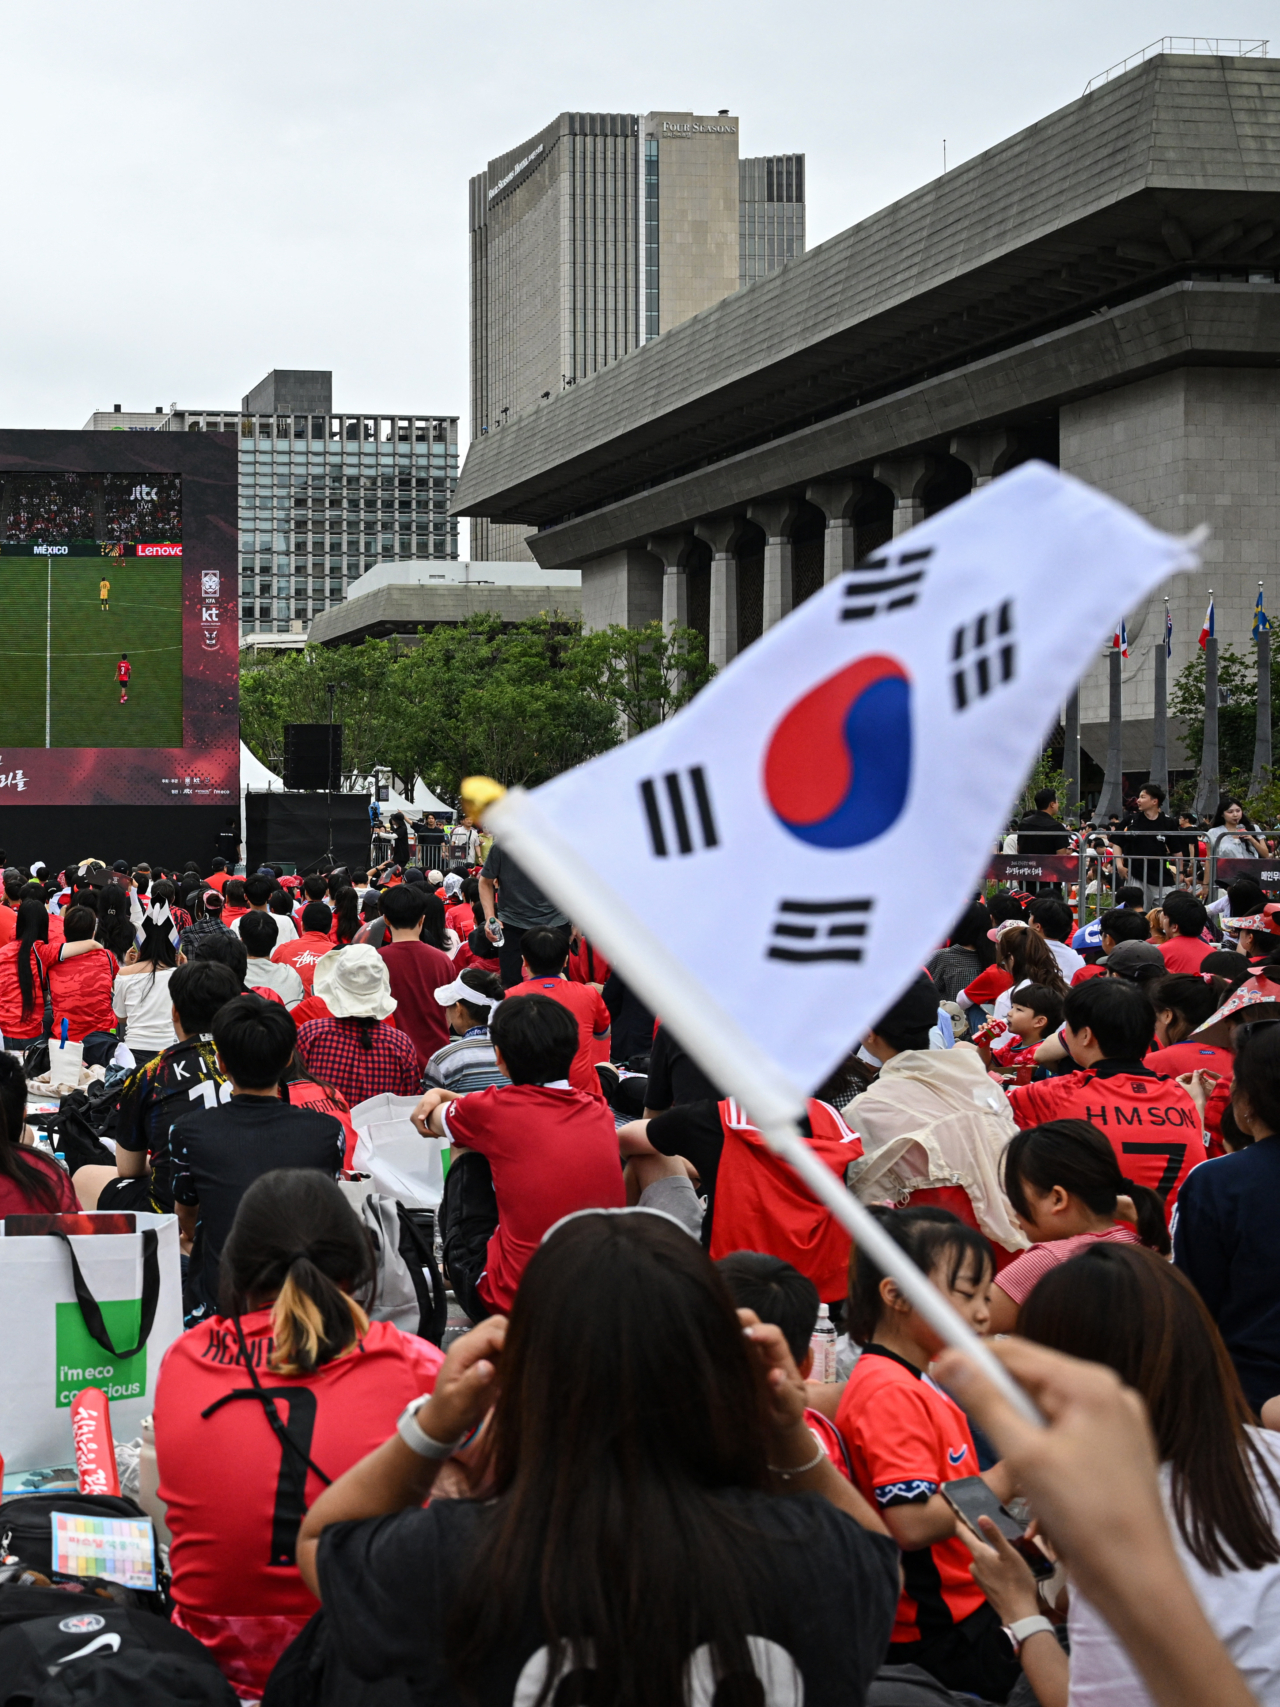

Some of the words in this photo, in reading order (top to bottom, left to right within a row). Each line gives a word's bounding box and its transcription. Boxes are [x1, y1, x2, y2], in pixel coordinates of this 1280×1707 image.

[662, 121, 690, 132] FOUR
[692, 122, 737, 134] SEASONS
[136, 502, 153, 510] LIVE
[33, 544, 69, 555] MÉXICO
[202, 607, 220, 622] kt
[1085, 1105, 1108, 1126] H
[1113, 1106, 1143, 1126] M
[1147, 1106, 1197, 1129] SON
[1121, 1141, 1188, 1203] 7
[60, 1365, 83, 1382] i'm
[84, 1366, 114, 1380] eco
